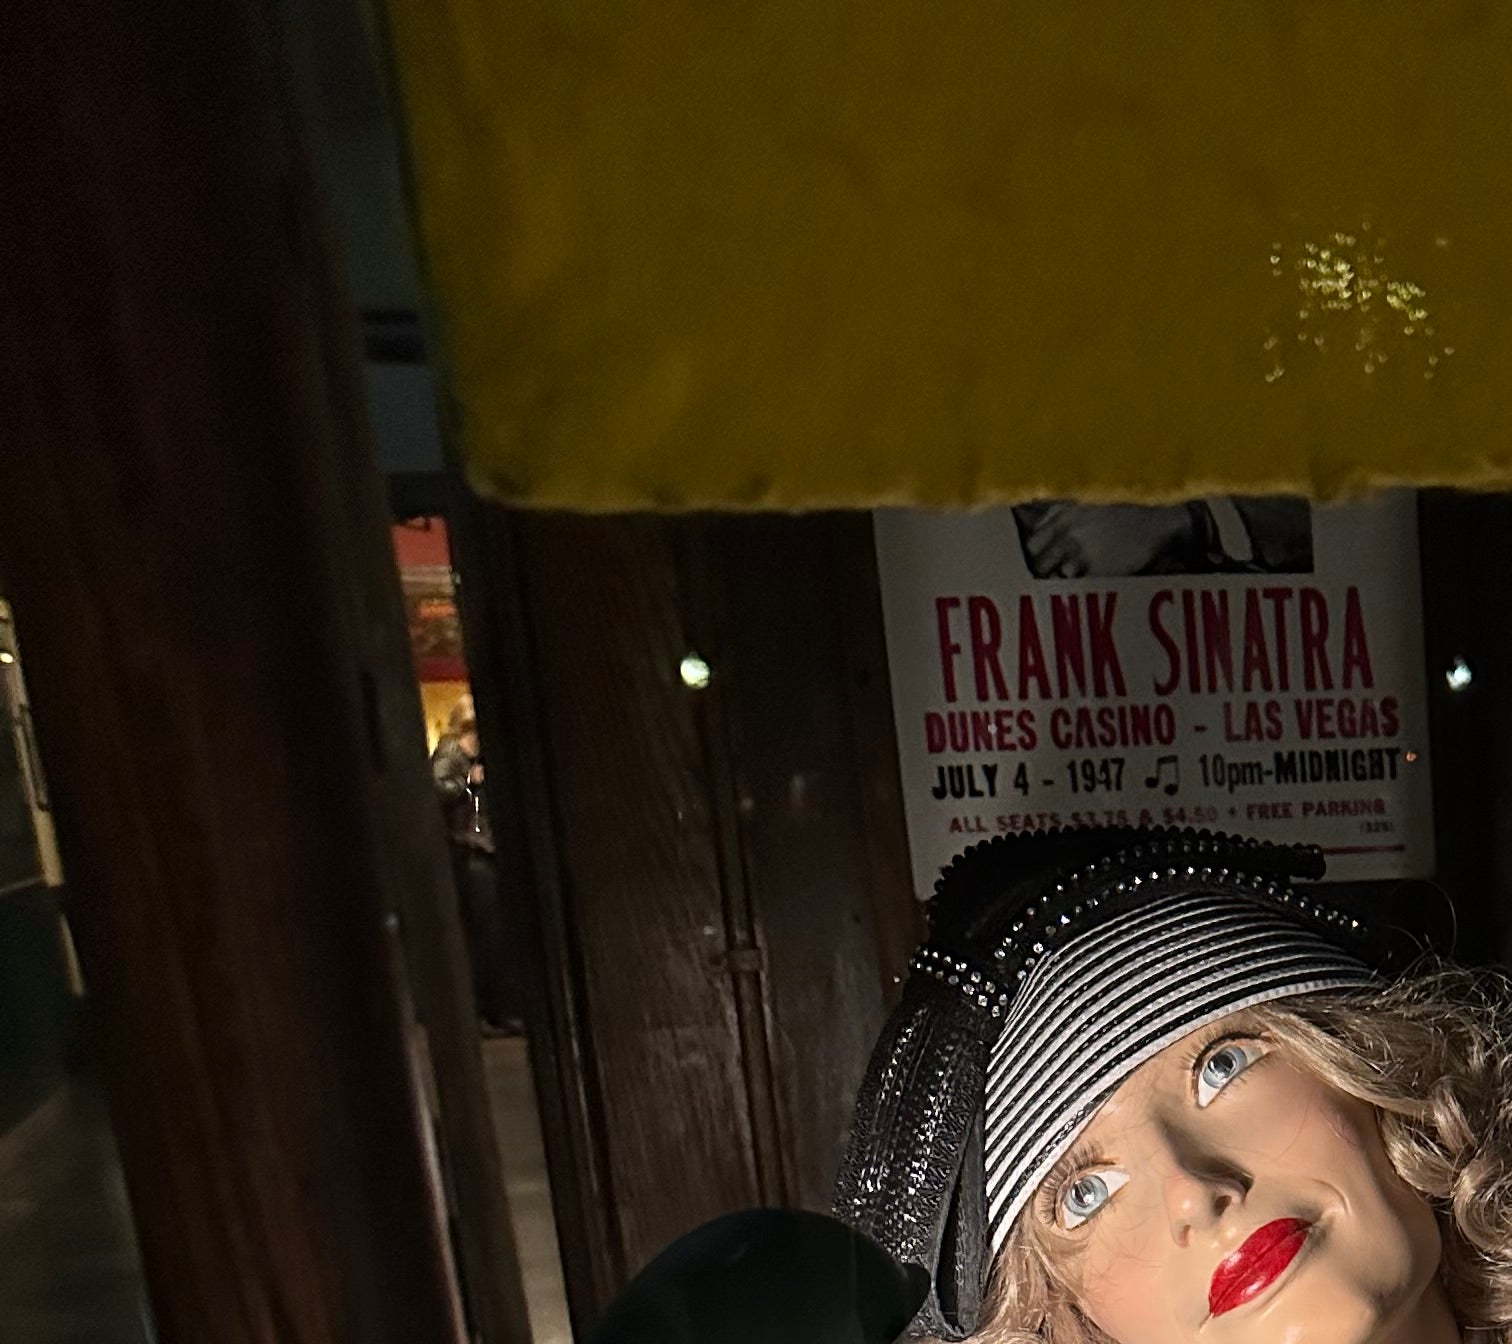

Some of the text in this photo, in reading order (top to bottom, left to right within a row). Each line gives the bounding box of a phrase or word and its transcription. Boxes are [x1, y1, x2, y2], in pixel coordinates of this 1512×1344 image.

[935, 586, 1374, 701] FRANK SINATRA
[1050, 704, 1175, 750] CASINO
[1223, 701, 1283, 743] LAS
[1294, 696, 1399, 741] VEGAS
[932, 763, 997, 799] JULY
[1014, 763, 1029, 795] 4
[1066, 758, 1125, 793] 1947
[1200, 748, 1400, 794] 10pm-MIDNIGHT
[950, 816, 988, 833] ALL
[997, 811, 1063, 831] SEATS
[1247, 802, 1293, 820] FREE
[1303, 799, 1386, 817] PARKING
